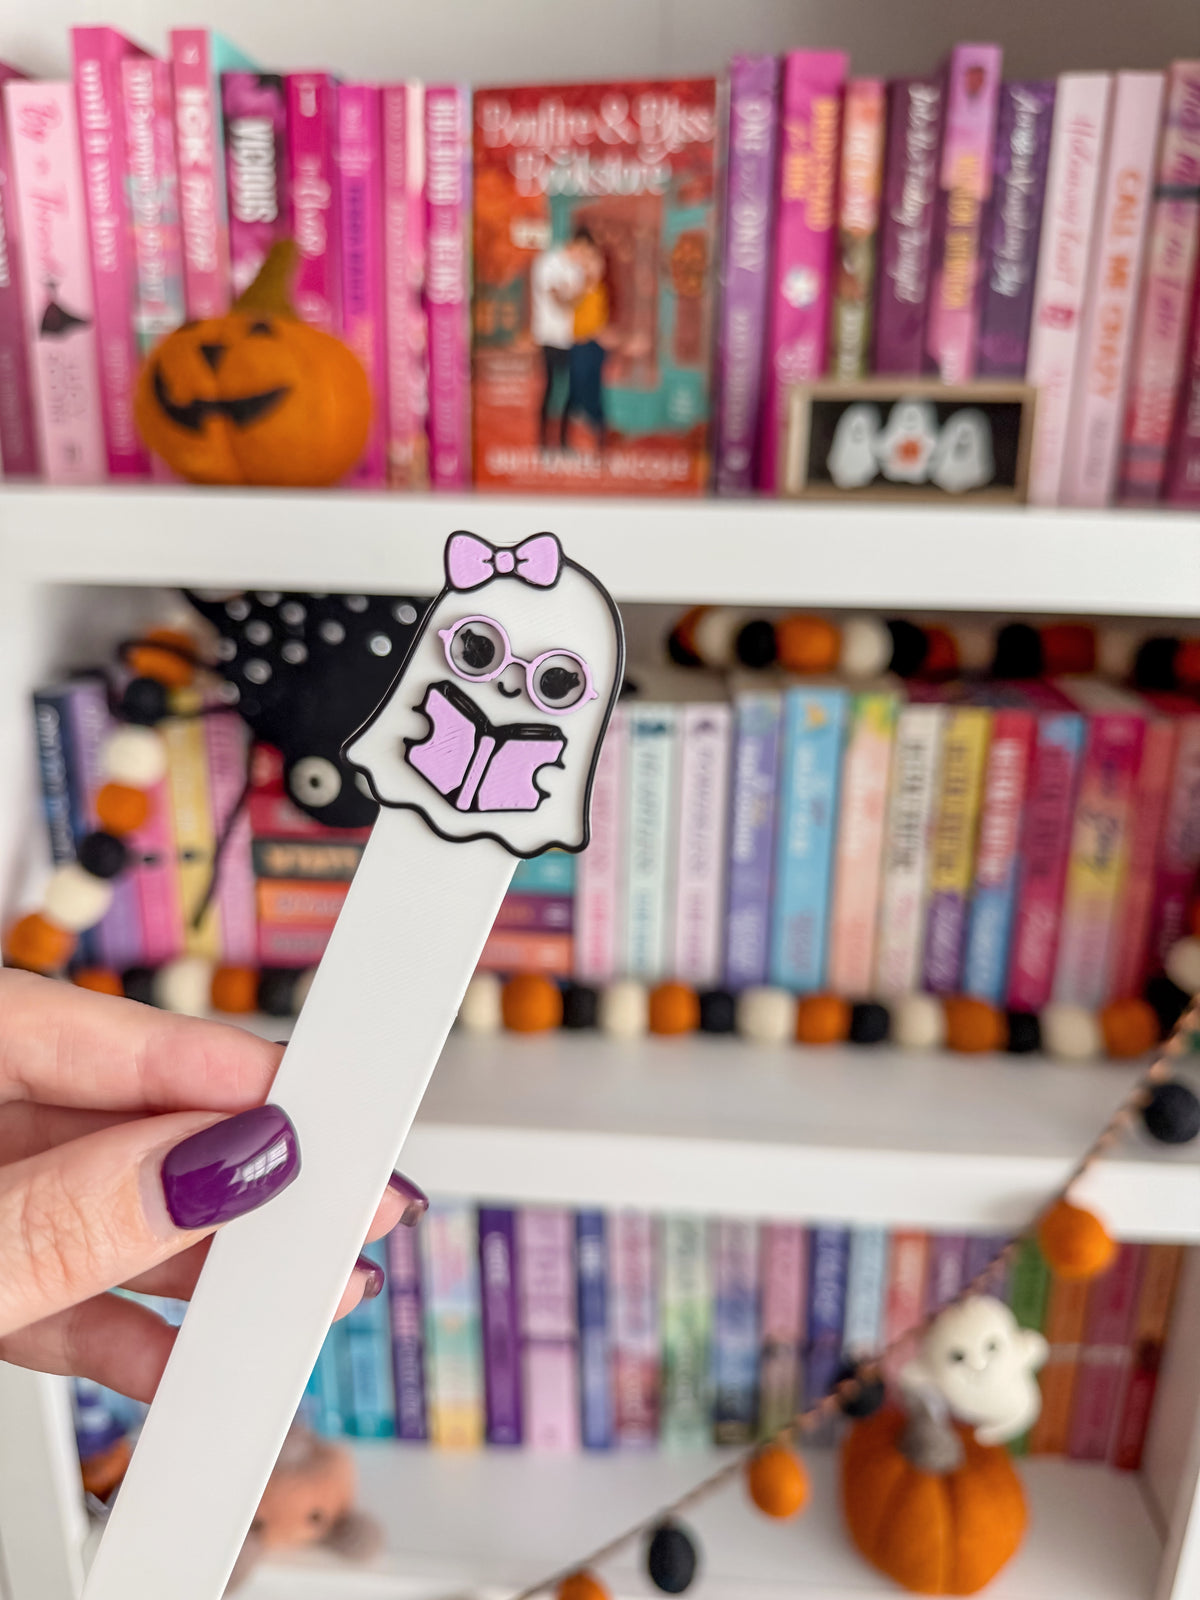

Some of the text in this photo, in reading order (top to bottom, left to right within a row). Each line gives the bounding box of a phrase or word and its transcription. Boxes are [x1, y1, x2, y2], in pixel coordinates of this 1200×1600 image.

[427, 98, 460, 206] HOLDING
[478, 94, 716, 157] Bonfire & Bliss
[734, 100, 770, 152] ONE
[231, 118, 278, 224] VICIOUS
[508, 146, 673, 197] Bookstore
[1113, 168, 1145, 240] CALL
[733, 204, 768, 273] ONLY
